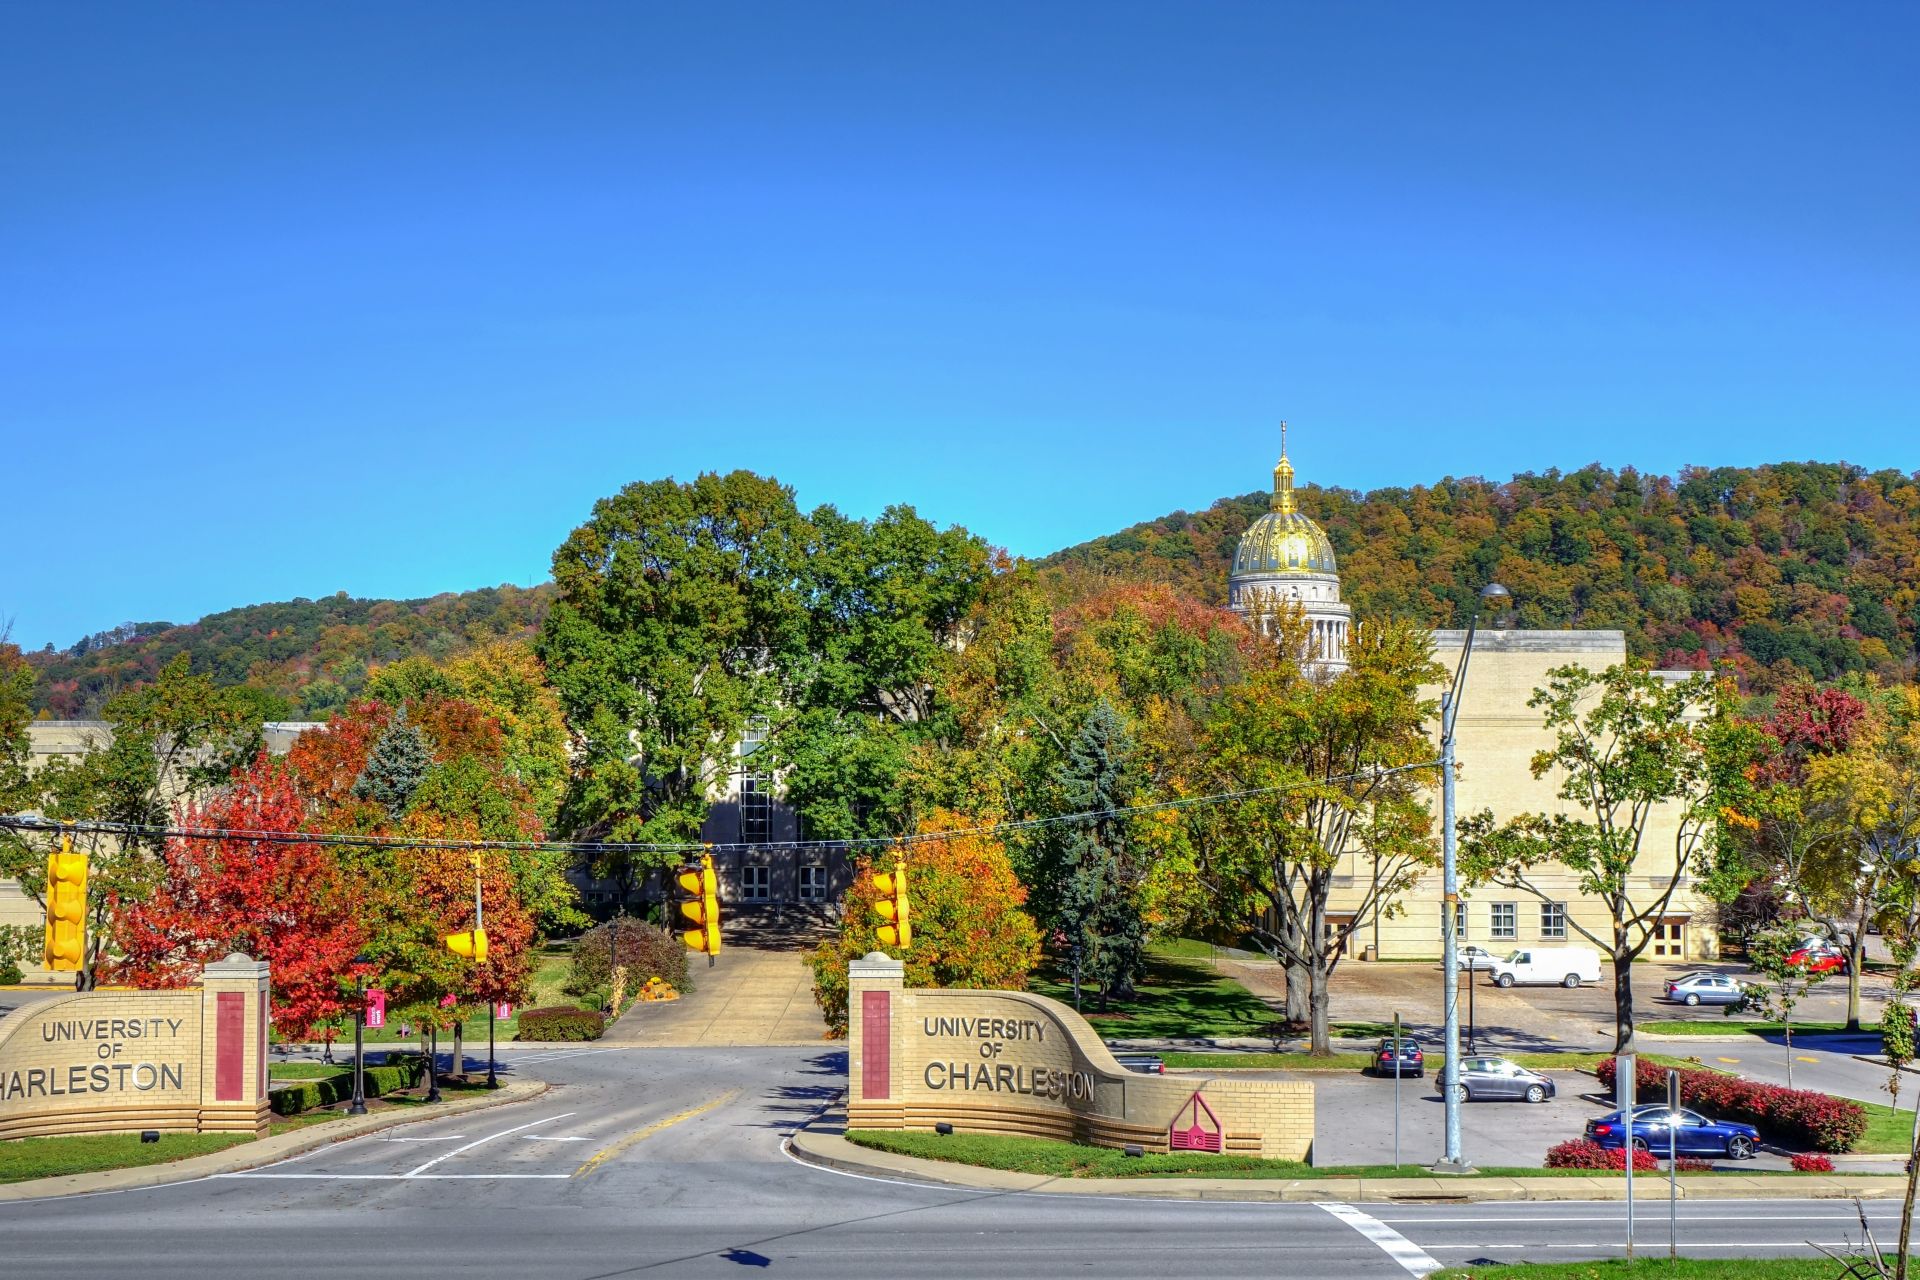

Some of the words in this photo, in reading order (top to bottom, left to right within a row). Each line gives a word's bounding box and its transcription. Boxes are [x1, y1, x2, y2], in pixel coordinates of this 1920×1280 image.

[42, 1018, 183, 1042] UNIVERSITY
[924, 1016, 1048, 1042] UNIVERSITY
[97, 1042, 123, 1059] OF
[979, 1041, 1003, 1058] OF
[924, 1061, 1095, 1101] CHARLESTON
